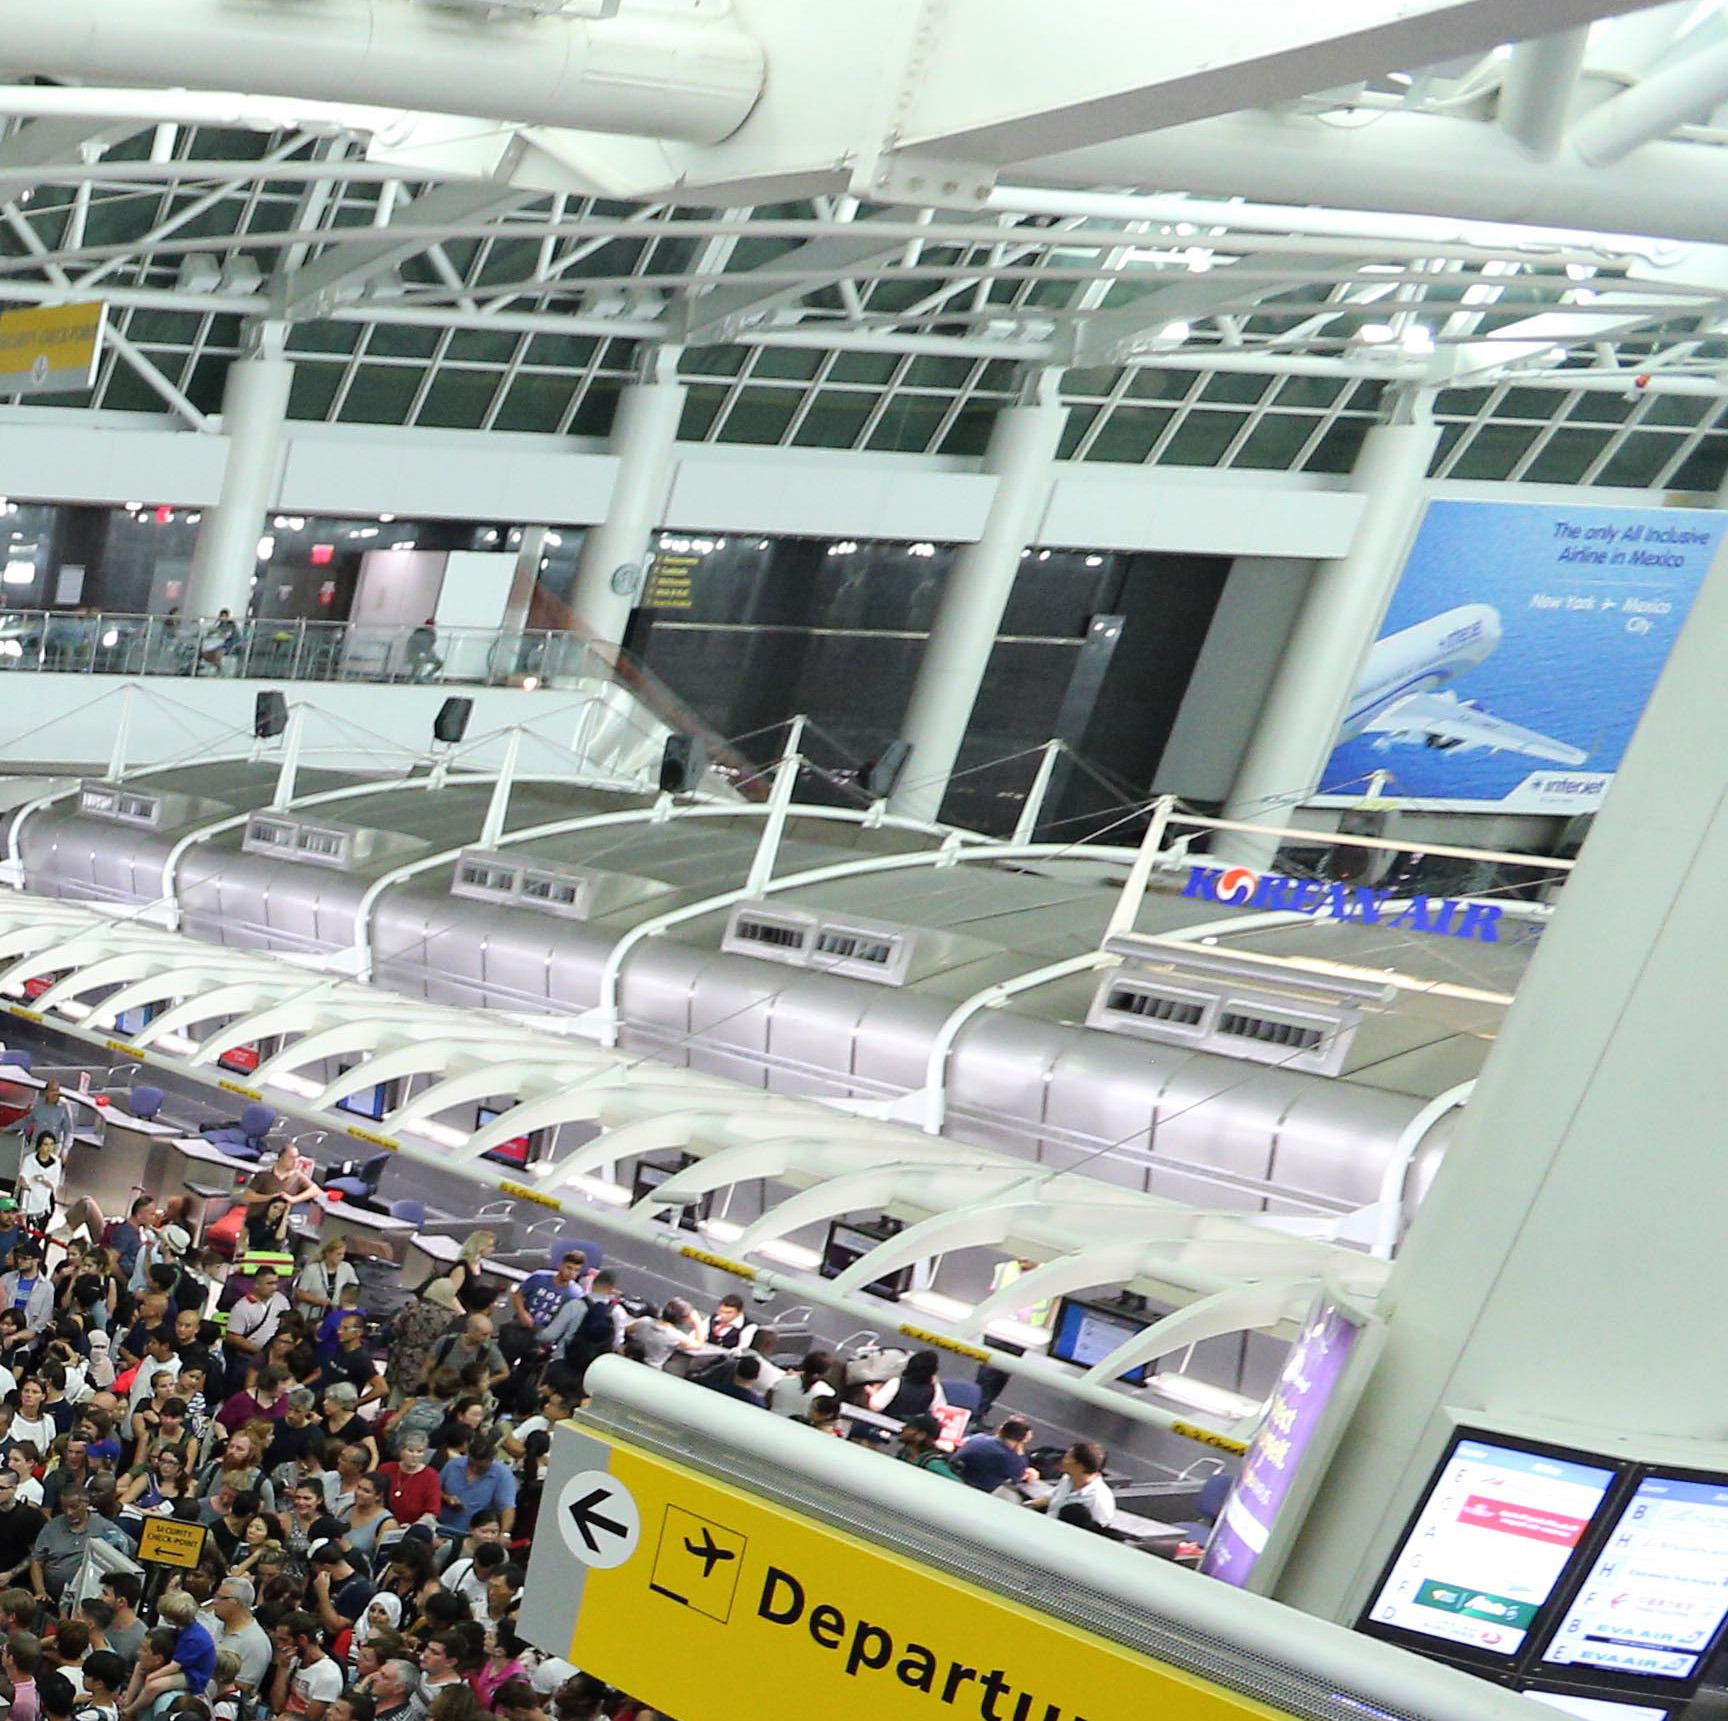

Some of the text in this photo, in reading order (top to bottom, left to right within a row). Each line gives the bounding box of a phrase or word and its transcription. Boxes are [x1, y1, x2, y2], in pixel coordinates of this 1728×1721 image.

[1553, 522, 1711, 545] The only All Inclusive
[1557, 547, 1686, 568] Airline in Mexico
[1530, 594, 1673, 614] New York Mexico
[1625, 616, 1655, 635] City
[1387, 893, 1504, 943] AIR
[1632, 1505, 1648, 1520] B
[147, 1532, 198, 1547] CHECK-POINT
[156, 1525, 192, 1537] SECURITY
